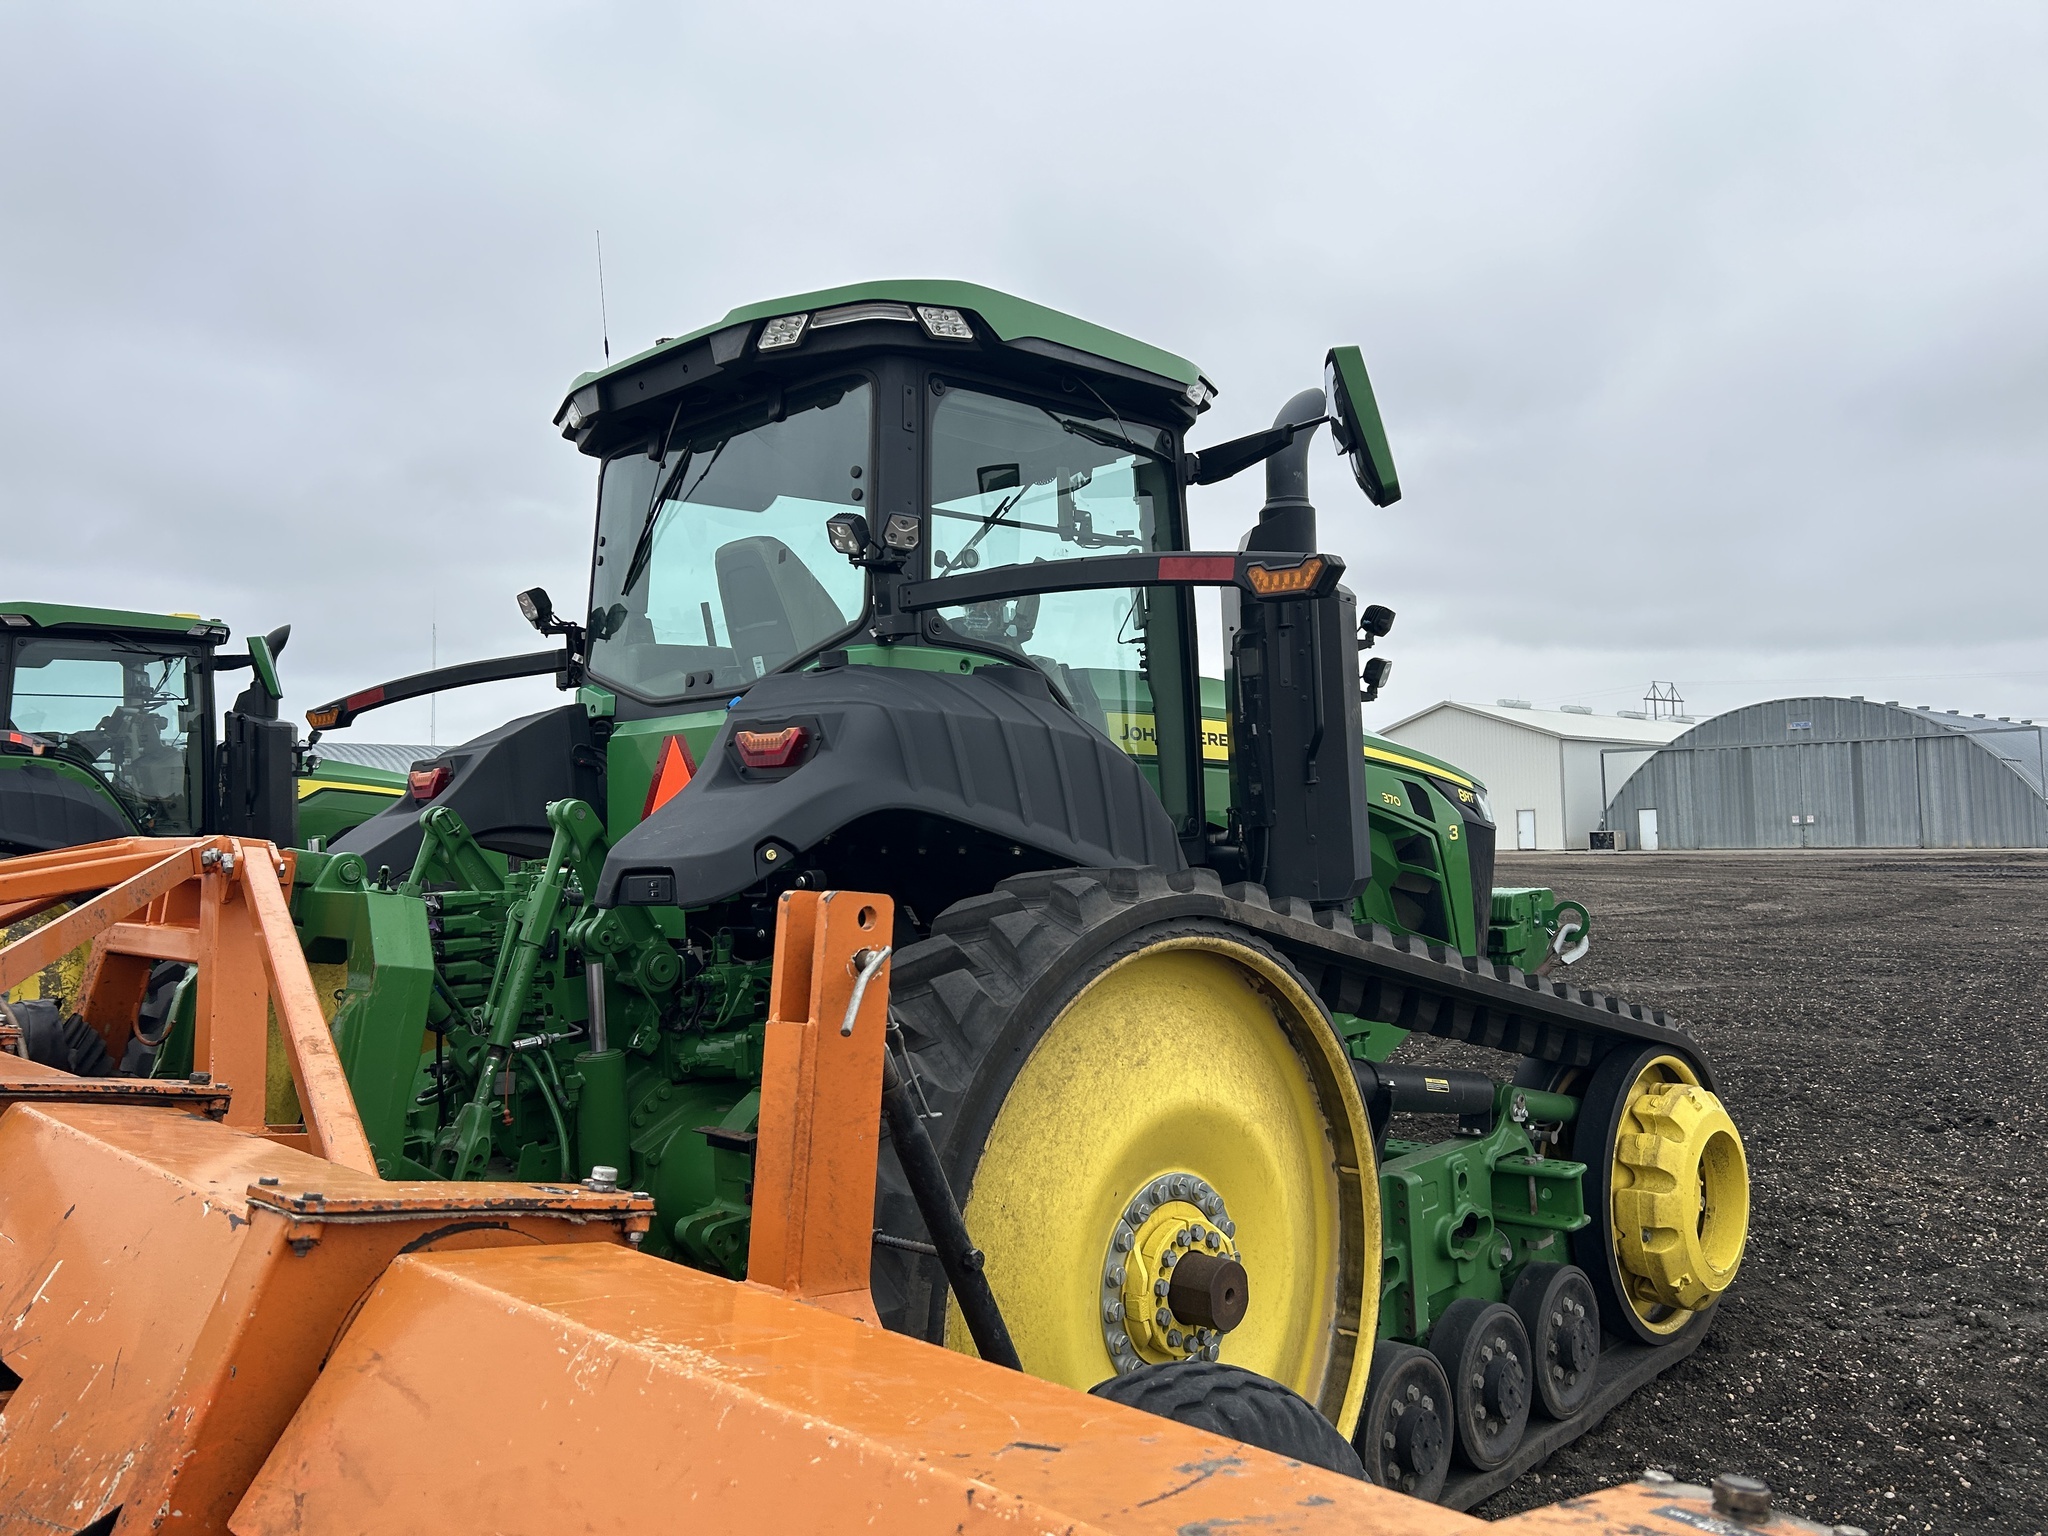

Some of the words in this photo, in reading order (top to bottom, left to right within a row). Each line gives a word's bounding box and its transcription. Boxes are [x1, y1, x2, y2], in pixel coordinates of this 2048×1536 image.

[1119, 723, 1154, 741] JOH
[1382, 793, 1401, 806] 370
[1457, 789, 1473, 803] 8RT
[1448, 825, 1459, 840] 3
